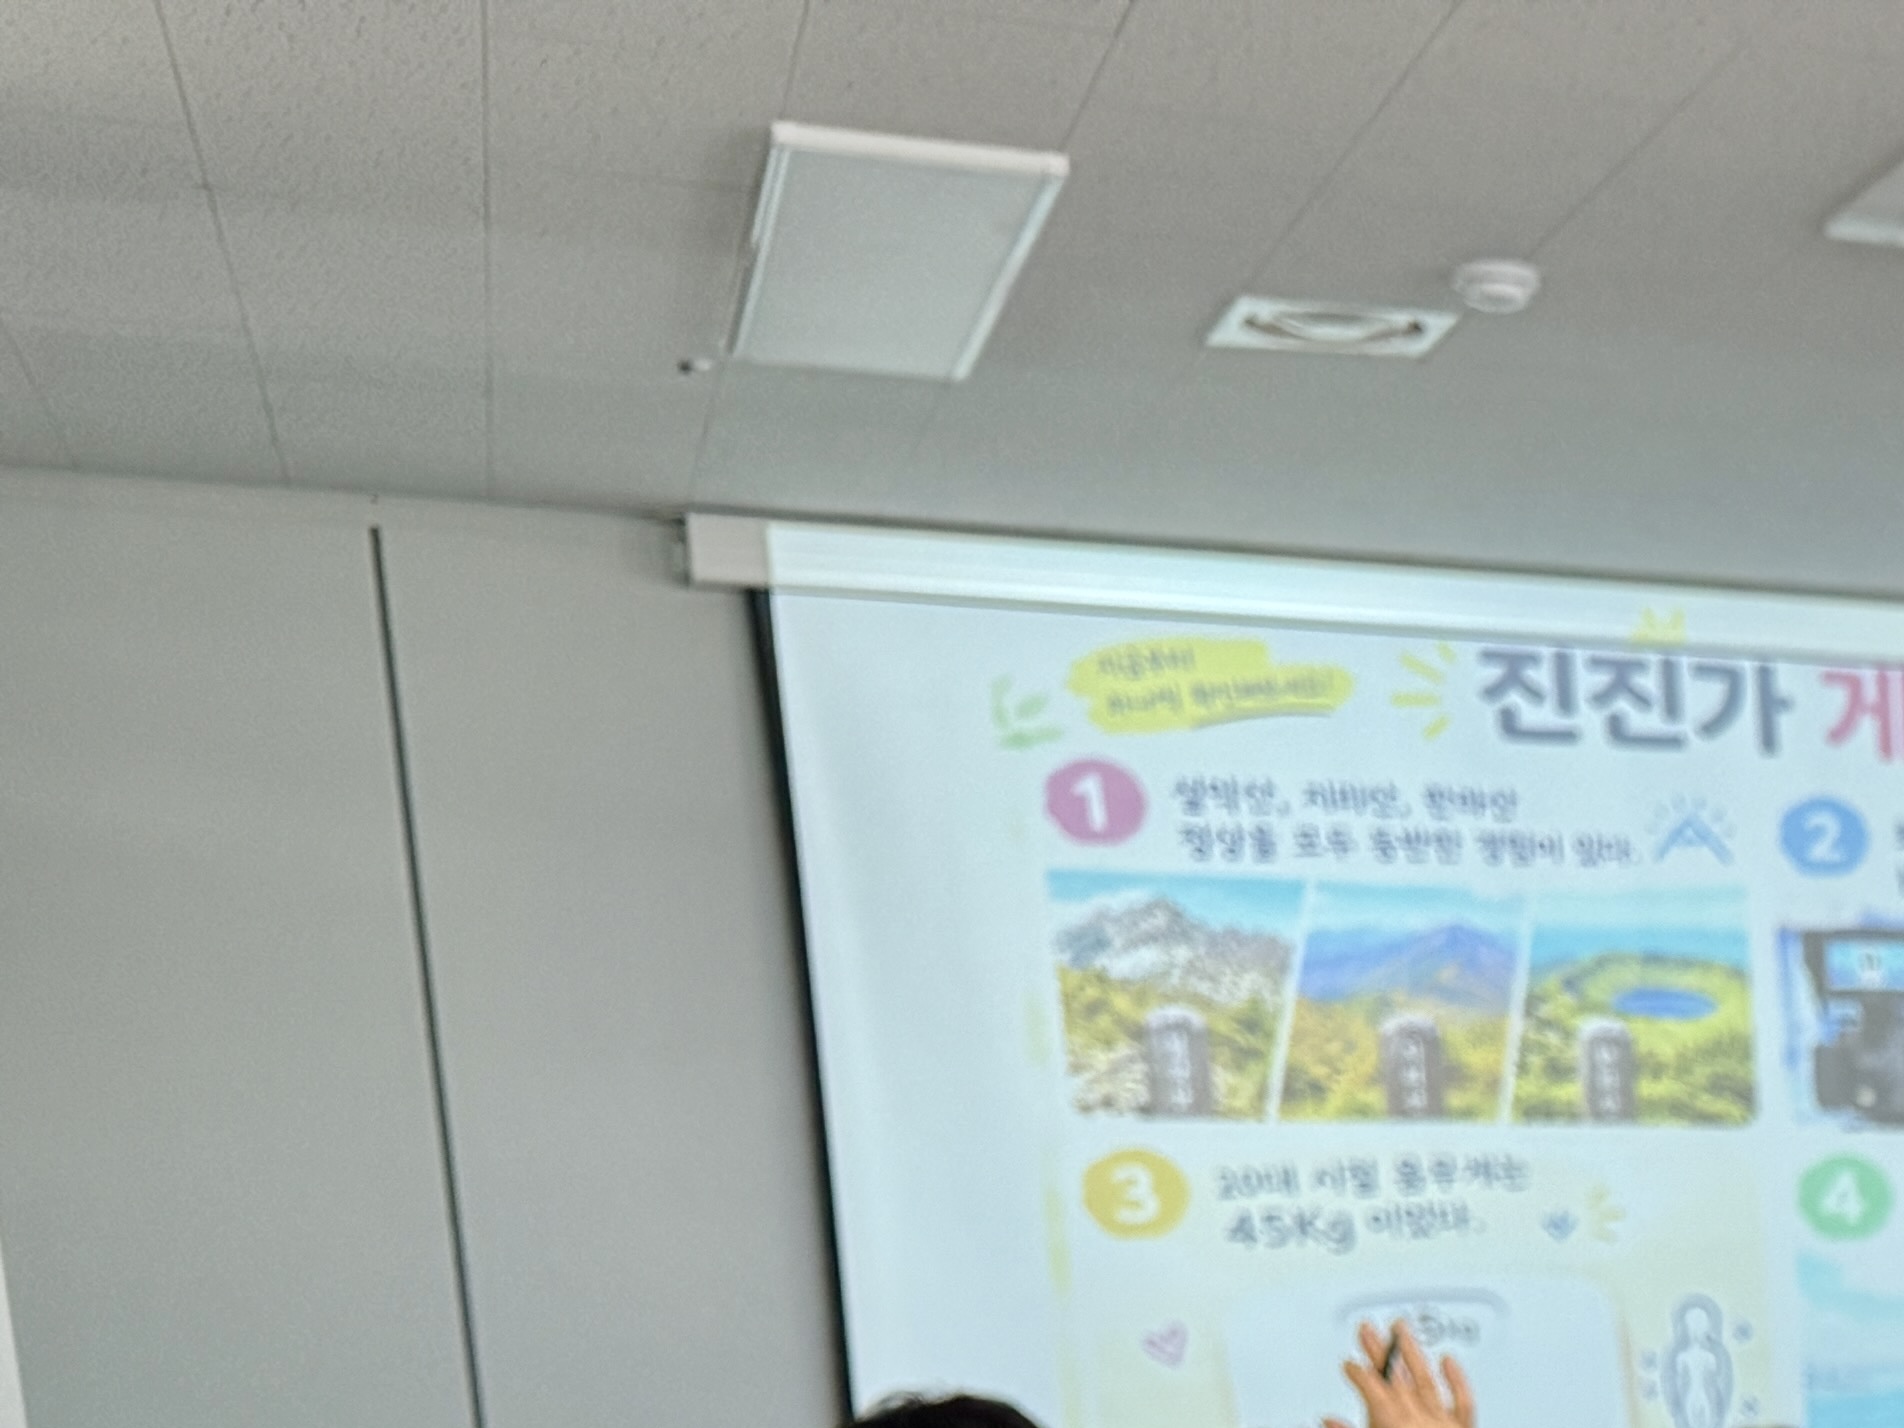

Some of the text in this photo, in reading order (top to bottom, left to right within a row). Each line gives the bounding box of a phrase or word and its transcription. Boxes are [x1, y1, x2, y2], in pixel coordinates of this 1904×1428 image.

[1478, 645, 1793, 756] 진진가
[1070, 777, 1108, 831] 1
[1295, 825, 1353, 860] 모두
[1805, 815, 1844, 860] 2
[1112, 1163, 1160, 1223] 3
[1820, 1171, 1866, 1223] 4
